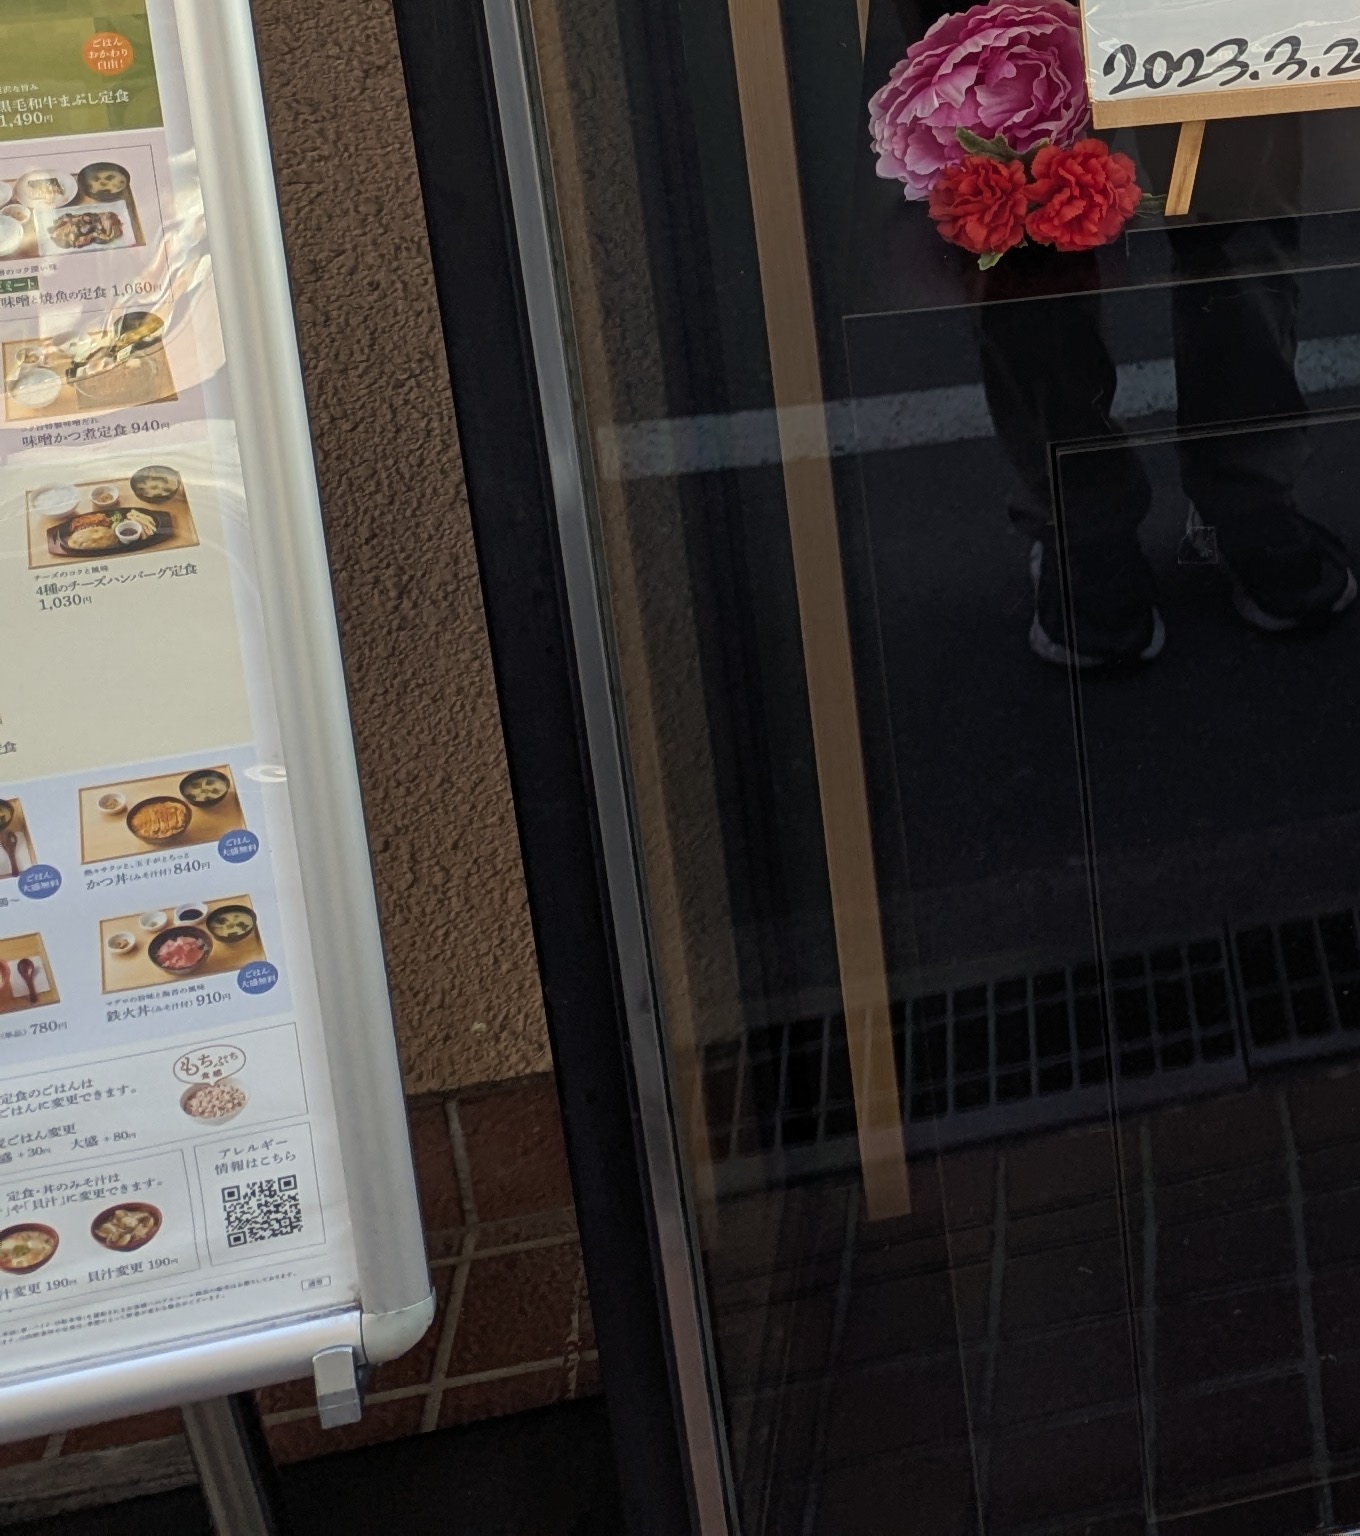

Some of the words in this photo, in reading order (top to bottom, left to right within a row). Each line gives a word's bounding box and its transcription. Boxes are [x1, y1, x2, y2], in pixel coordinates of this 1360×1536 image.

[93, 38, 122, 47] ごはん
[89, 49, 128, 59] おかわり
[112, 282, 162, 297] 1,060円
[22, 423, 128, 448] 味噌かつ煮定食
[131, 420, 170, 434] 940円
[35, 563, 198, 596] 4種のチーズハンバーグ定食
[39, 594, 92, 611] 1,030円
[173, 860, 211, 875] 840円
[196, 991, 231, 1006] 910円
[29, 1020, 68, 1036] 780円
[218, 1139, 288, 1159] アレルギー
[214, 1151, 297, 1175] 情報はこちら
